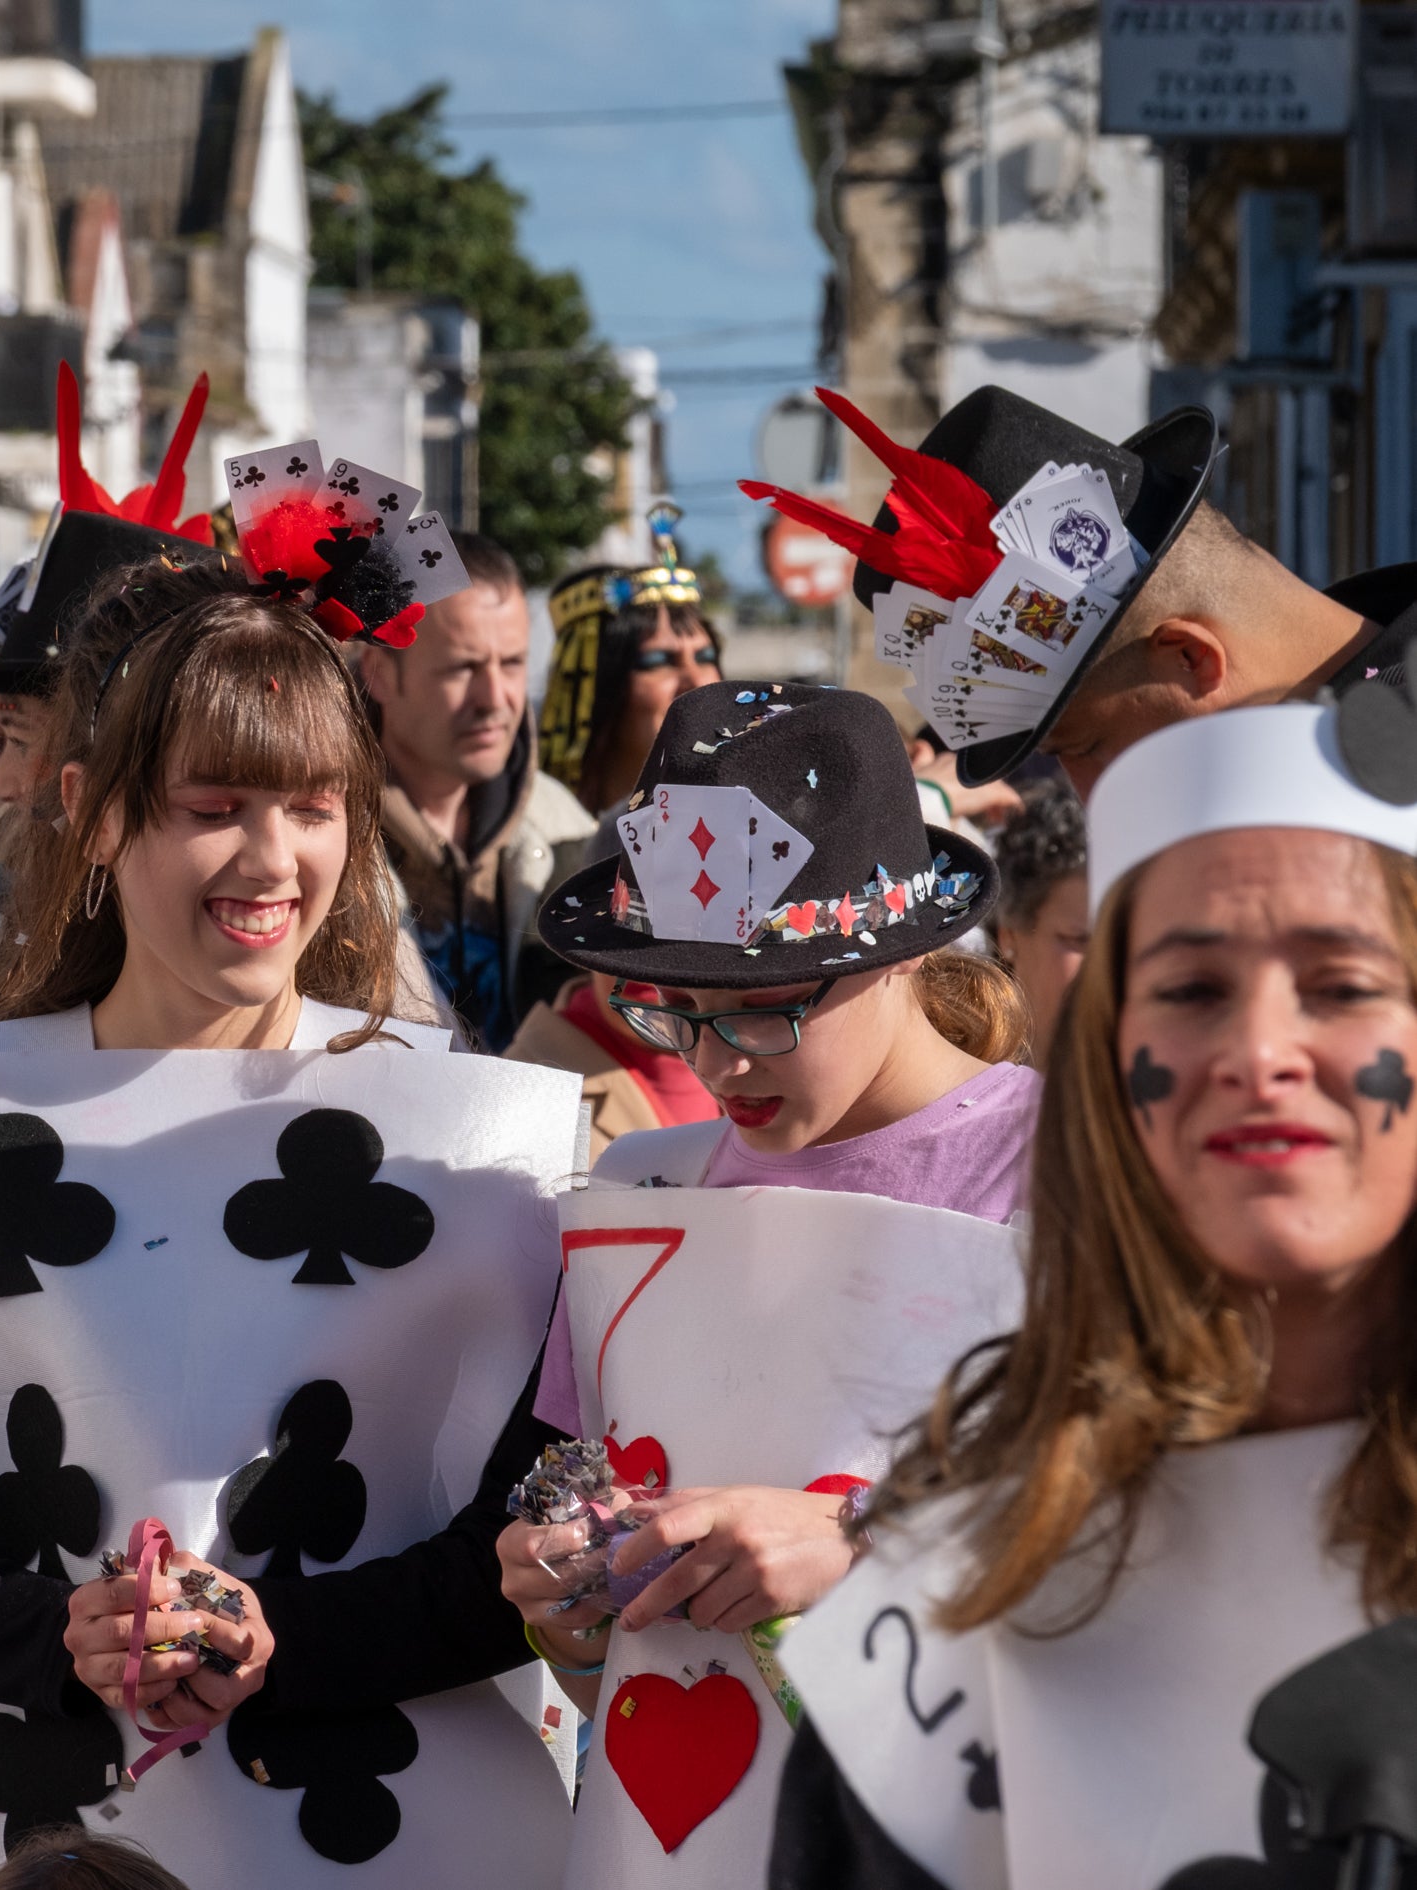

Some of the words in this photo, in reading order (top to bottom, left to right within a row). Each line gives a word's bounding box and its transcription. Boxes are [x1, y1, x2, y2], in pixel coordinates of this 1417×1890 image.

[230, 461, 242, 477] 5
[334, 463, 348, 478] 9
[420, 516, 438, 529] 3
[1087, 602, 1108, 619] K
[975, 612, 994, 628] K
[884, 647, 901, 658] K
[952, 660, 969, 671] Q
[933, 706, 953, 718] 10
[659, 791, 669, 809] 2
[623, 821, 638, 841] 3
[736, 920, 746, 938] 2
[561, 1227, 686, 1404] 7
[862, 1606, 966, 1735] 2
